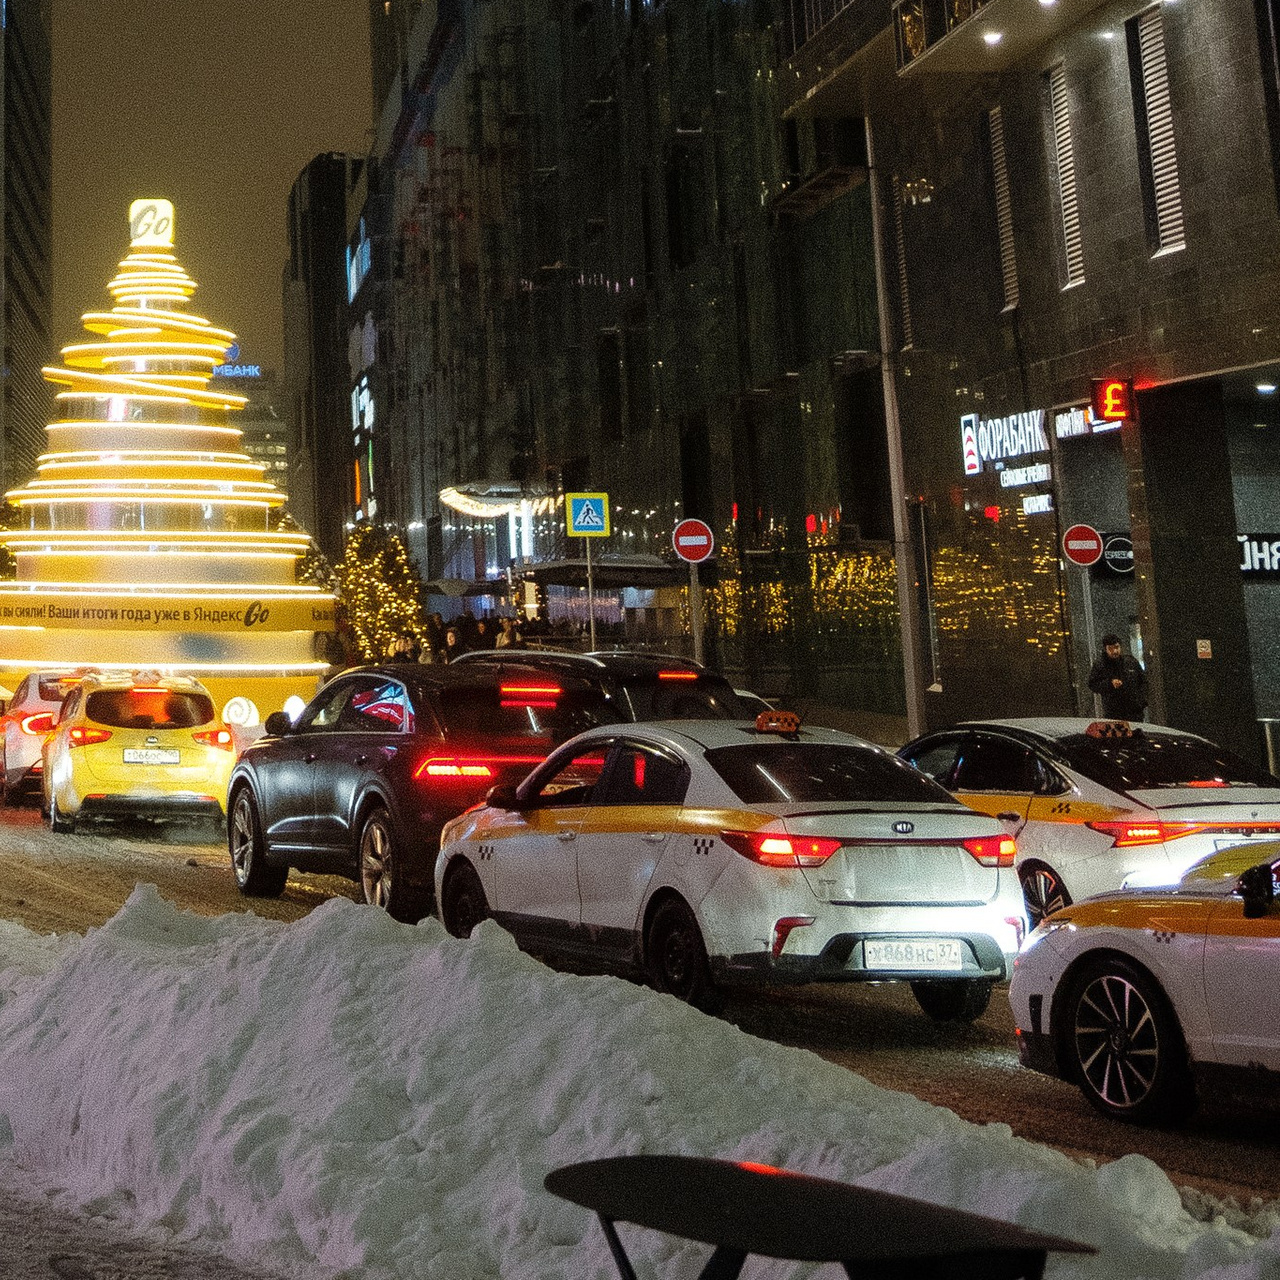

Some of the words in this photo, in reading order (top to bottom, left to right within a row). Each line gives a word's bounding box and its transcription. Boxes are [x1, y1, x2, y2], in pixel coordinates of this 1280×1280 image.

[130, 205, 170, 240] Go
[978, 409, 1048, 461] ФОРАБАНК
[3, 607, 14, 618] вы
[15, 605, 46, 618] сияли!
[48, 605, 79, 619] Ваши
[82, 608, 118, 620] итоги
[121, 609, 151, 622] года
[154, 608, 180, 624] уже
[183, 610, 191, 621] в
[194, 606, 242, 623] Яндекс
[244, 600, 270, 627] Go
[896, 823, 912, 832] KIA
[939, 944, 952, 957] 37
